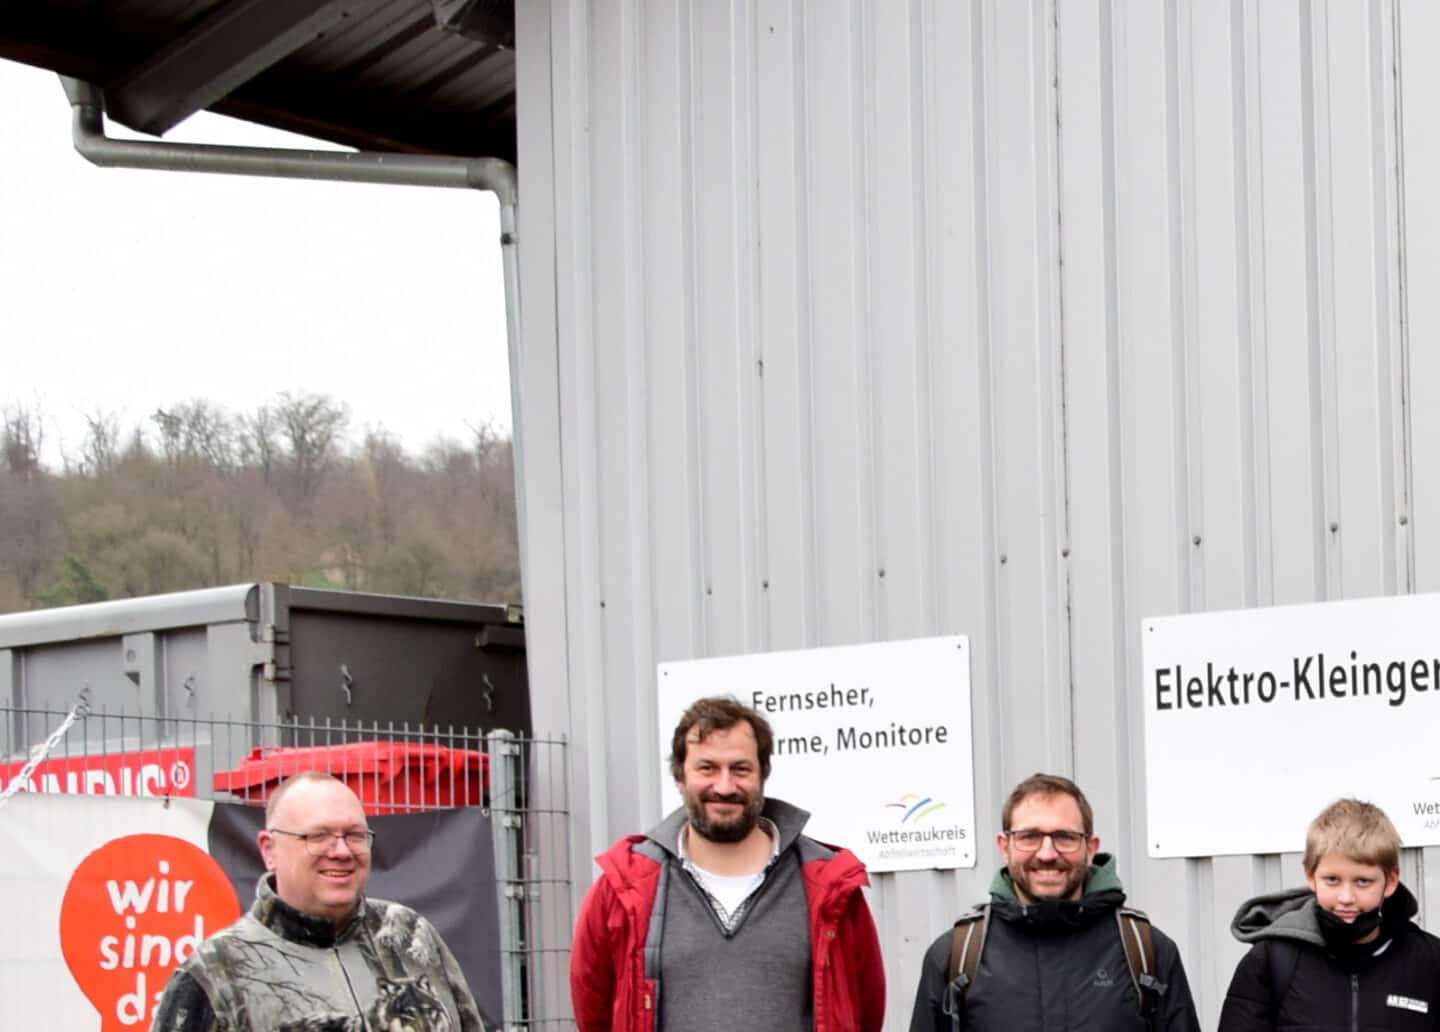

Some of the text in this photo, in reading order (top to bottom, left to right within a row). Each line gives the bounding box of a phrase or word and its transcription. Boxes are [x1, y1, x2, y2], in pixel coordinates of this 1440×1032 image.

[752, 683, 874, 712] Fernseher,
[776, 722, 948, 756] rme, Monitore
[866, 823, 967, 845] Wetteraukreis
[105, 860, 194, 916] wir
[99, 914, 205, 971] sind
